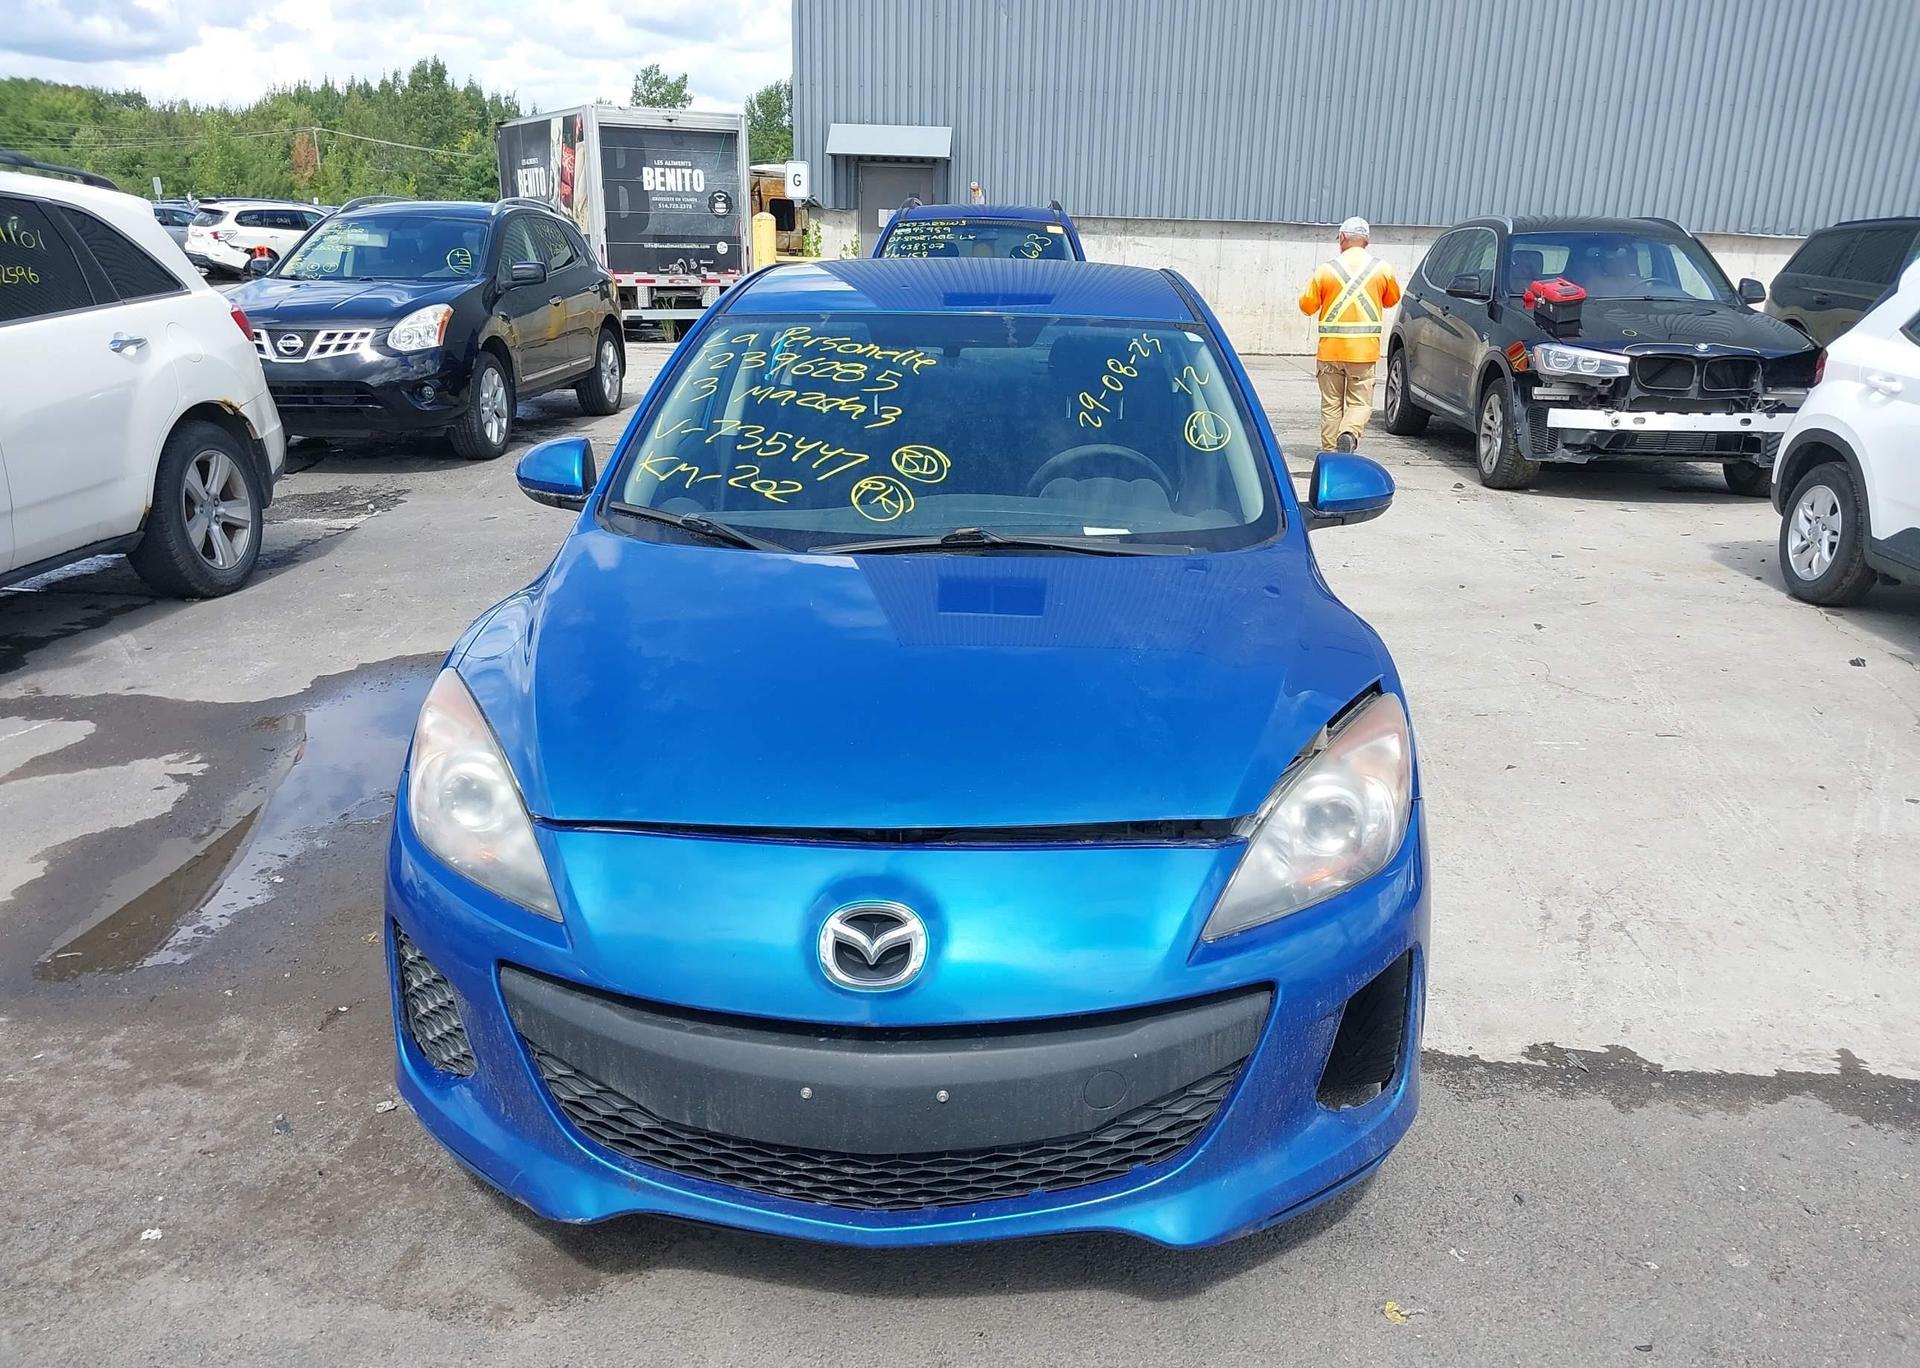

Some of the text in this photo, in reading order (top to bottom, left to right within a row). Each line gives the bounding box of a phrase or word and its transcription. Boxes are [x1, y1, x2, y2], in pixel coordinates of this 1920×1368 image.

[517, 166, 547, 198] BENITO
[642, 166, 705, 193] BENITO
[793, 173, 802, 187] G
